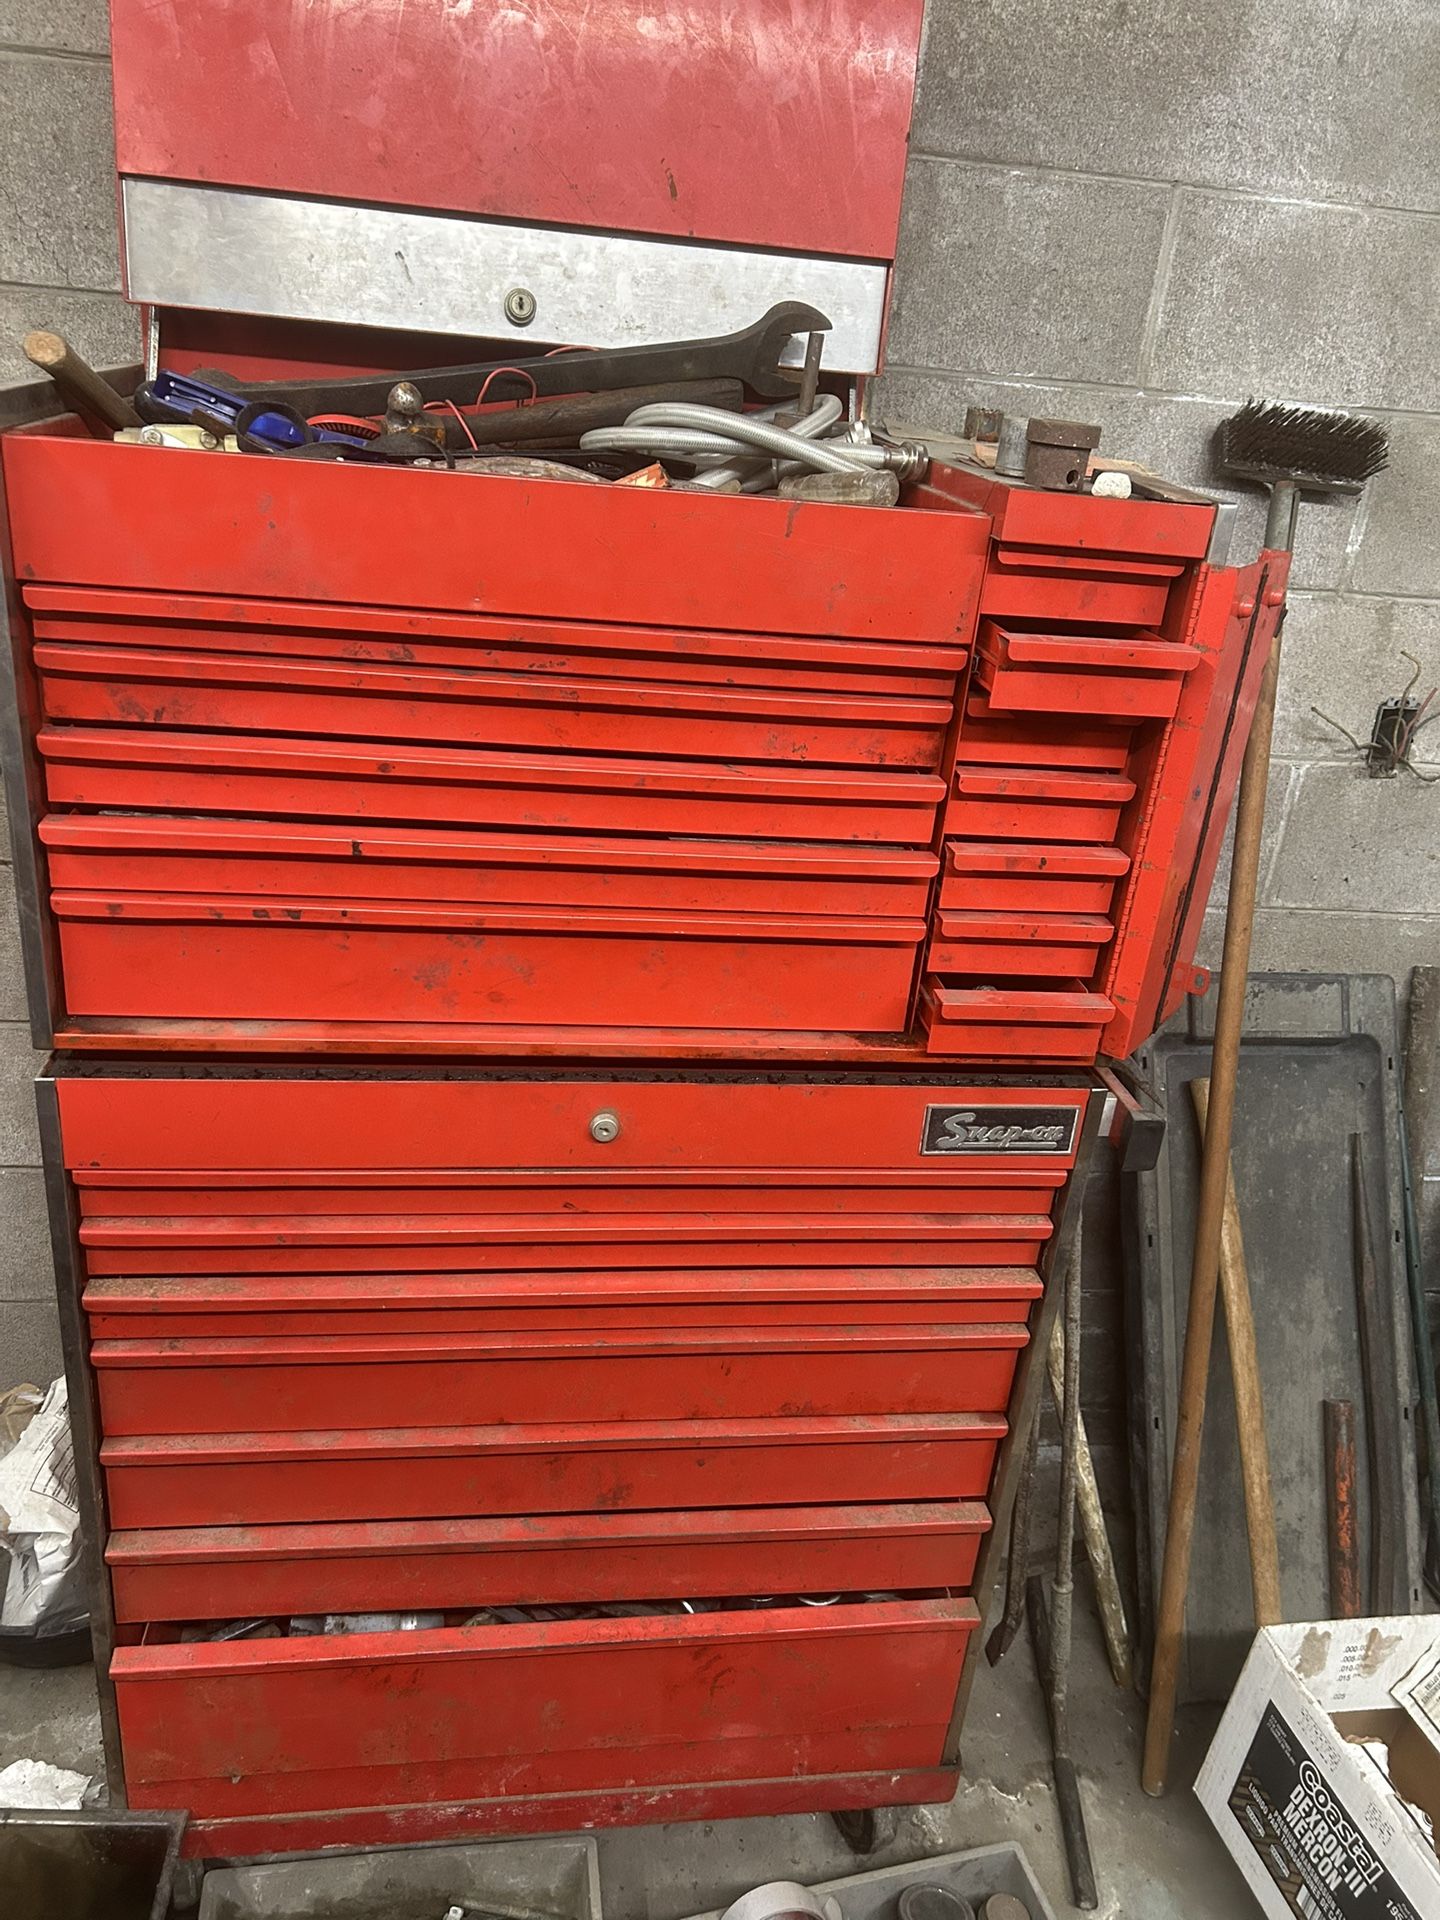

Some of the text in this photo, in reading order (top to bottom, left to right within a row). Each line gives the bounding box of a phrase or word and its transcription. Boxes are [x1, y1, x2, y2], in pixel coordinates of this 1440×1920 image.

[936, 1112, 1065, 1149] Snap-on
[1267, 1812, 1281, 1837] PARA
[1273, 1809, 1299, 1850] PREMIUM
[1283, 1801, 1342, 1891] MERCON
[1290, 1784, 1367, 1898] DEXRON-III
[1300, 1760, 1384, 1884] Coastal
